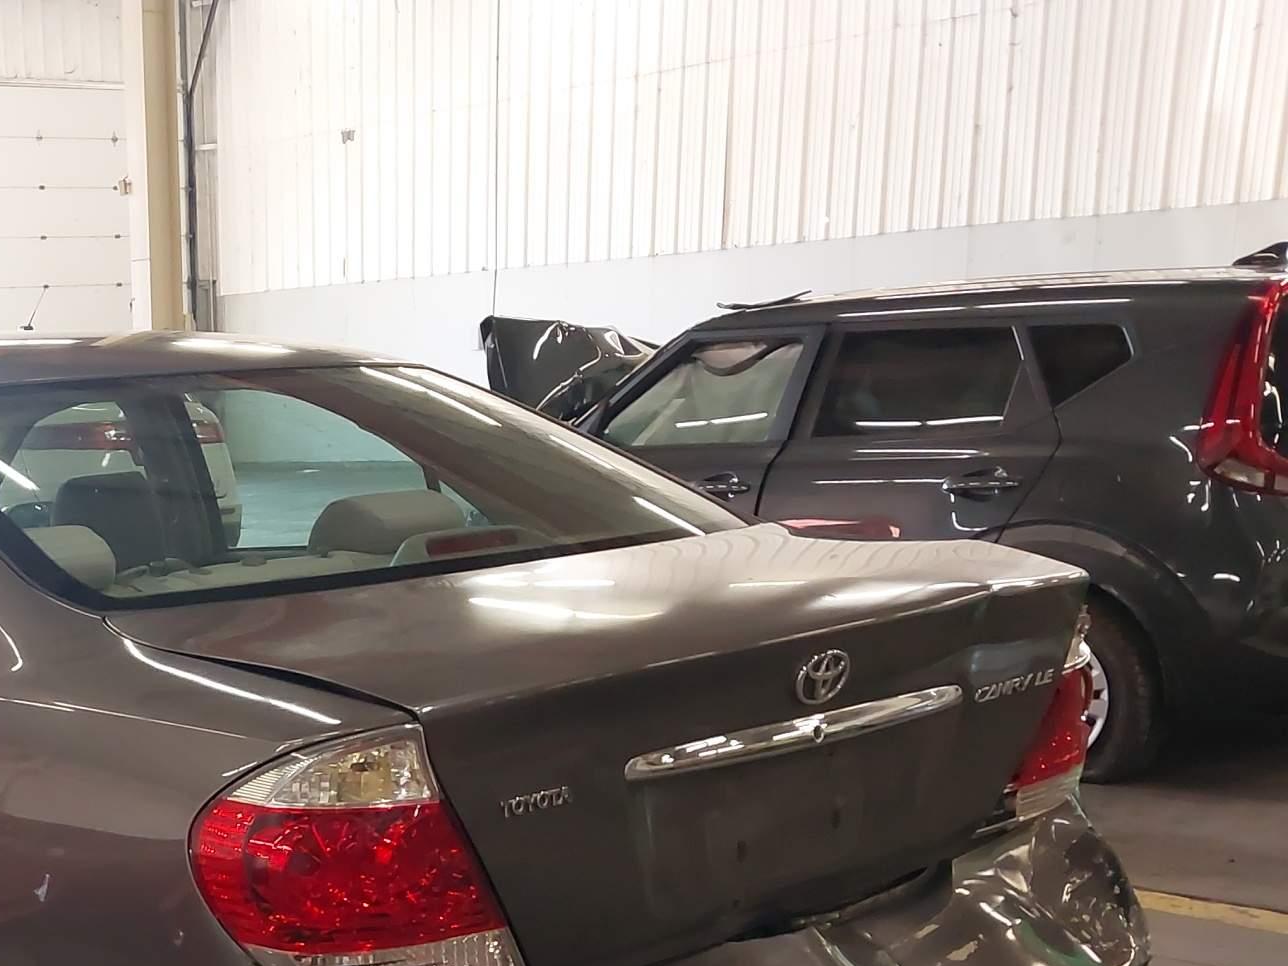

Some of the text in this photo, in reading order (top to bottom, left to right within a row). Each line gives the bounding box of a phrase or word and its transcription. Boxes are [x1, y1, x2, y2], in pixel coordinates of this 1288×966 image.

[975, 668, 1054, 702] CAMRY LE
[500, 785, 570, 818] TOYOTA
